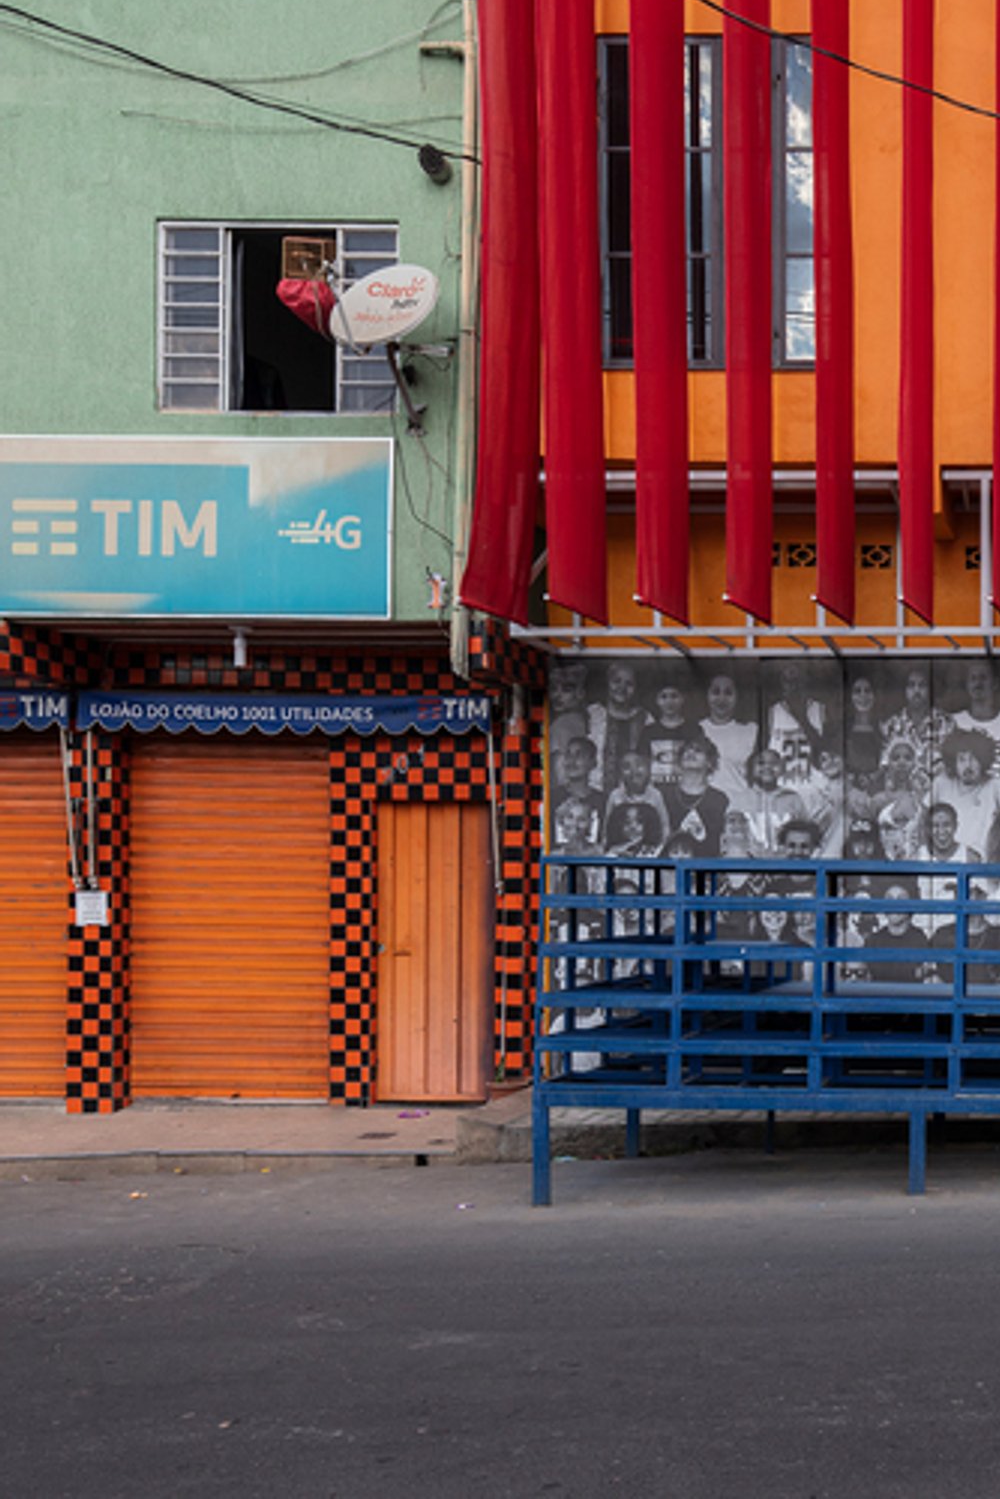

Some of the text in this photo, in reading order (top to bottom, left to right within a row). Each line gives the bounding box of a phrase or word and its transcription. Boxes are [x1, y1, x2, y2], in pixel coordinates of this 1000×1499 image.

[91, 500, 218, 557] TIM
[292, 510, 361, 549] 4G
[20, 696, 66, 717] TIM
[89, 701, 373, 722] LOJÃO DO COELHO 1001 UTILIDADES
[443, 699, 488, 719] TIM
